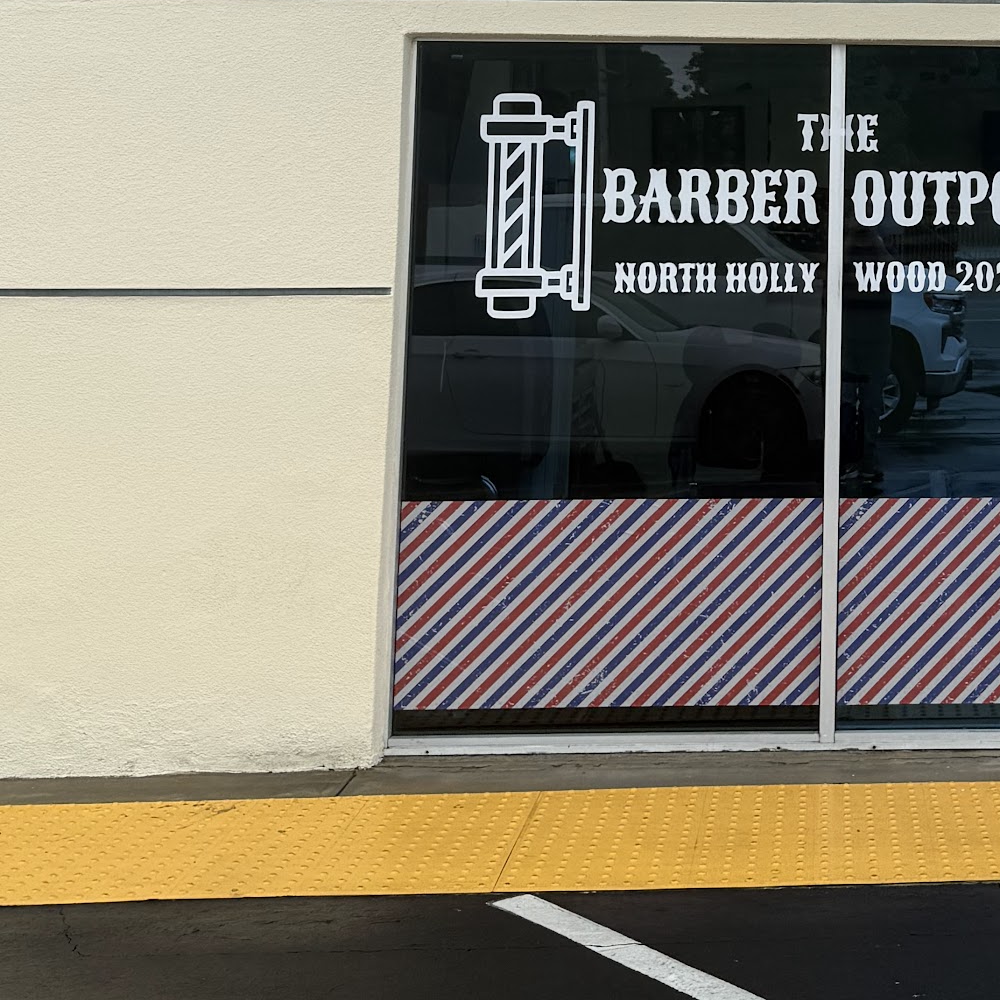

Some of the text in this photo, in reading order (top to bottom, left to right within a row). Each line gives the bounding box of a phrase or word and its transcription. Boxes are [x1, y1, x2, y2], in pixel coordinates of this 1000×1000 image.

[797, 113, 879, 153] THE
[601, 167, 820, 225] BARBER
[613, 261, 717, 294] NORTH
